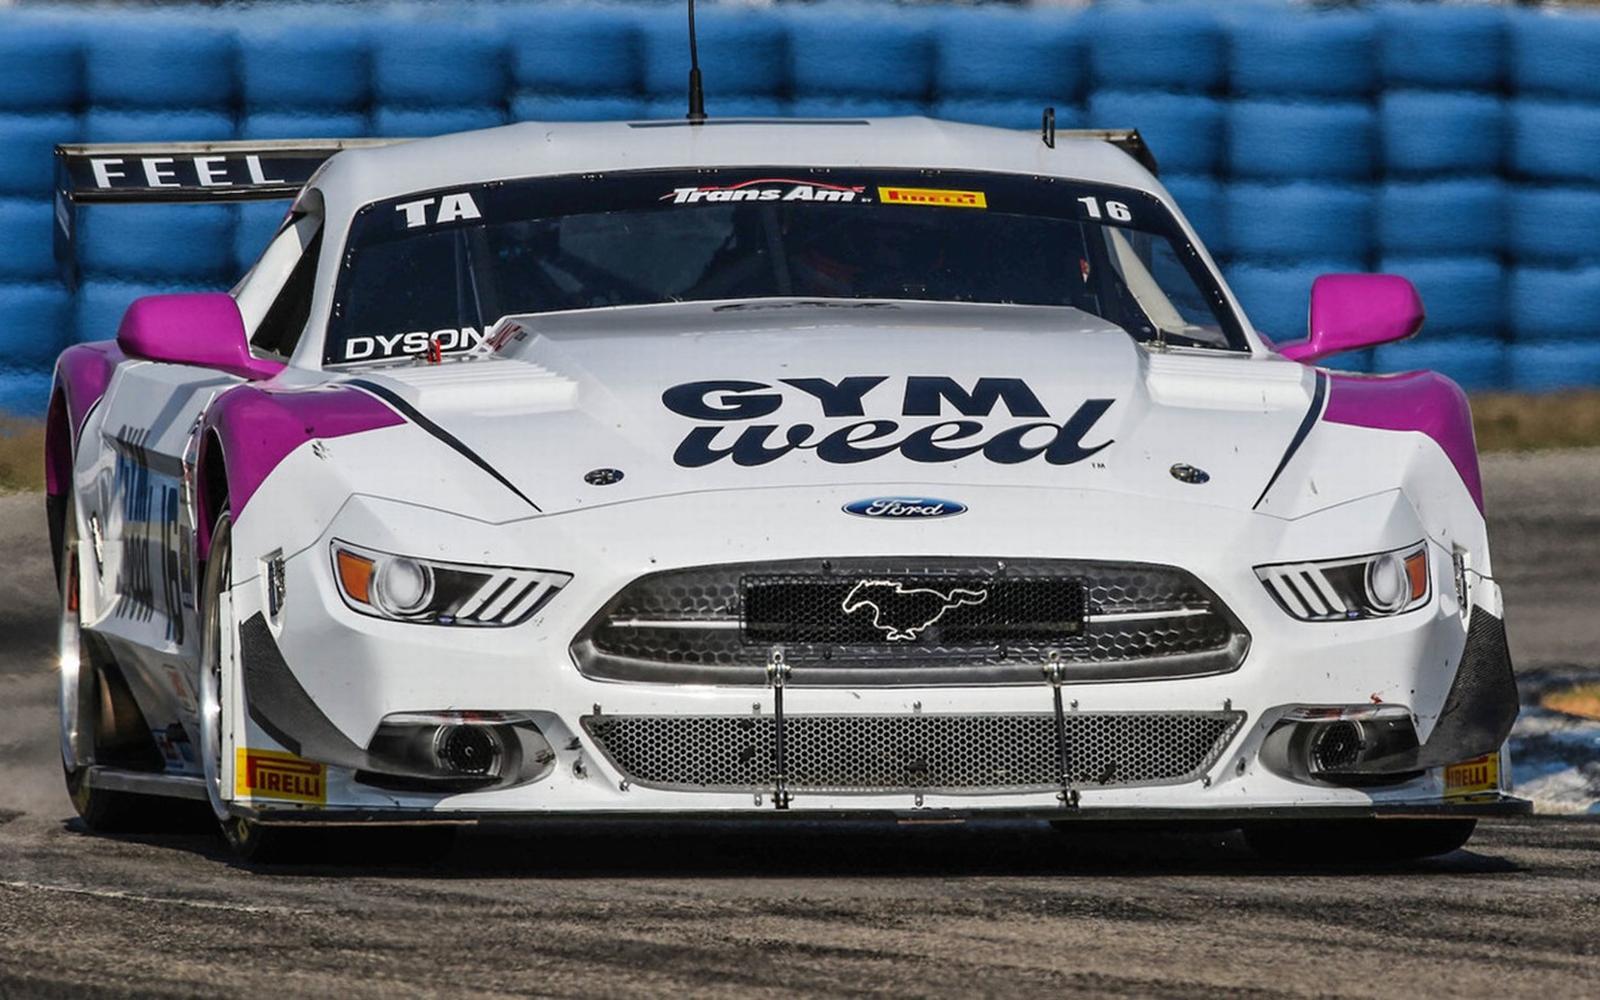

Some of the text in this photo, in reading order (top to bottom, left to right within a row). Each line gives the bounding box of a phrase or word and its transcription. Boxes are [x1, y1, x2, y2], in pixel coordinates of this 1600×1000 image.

[89, 155, 285, 189] FEEL
[395, 192, 483, 228] TA
[673, 187, 782, 203] Trans
[782, 186, 857, 202] Am
[887, 190, 977, 205] PIRELLI
[1077, 196, 1132, 222] 16
[345, 325, 493, 359] DYSON
[661, 376, 1051, 421] GYM
[672, 399, 1117, 468] weed
[864, 498, 945, 516] Ford
[246, 755, 321, 798] PIRELLI
